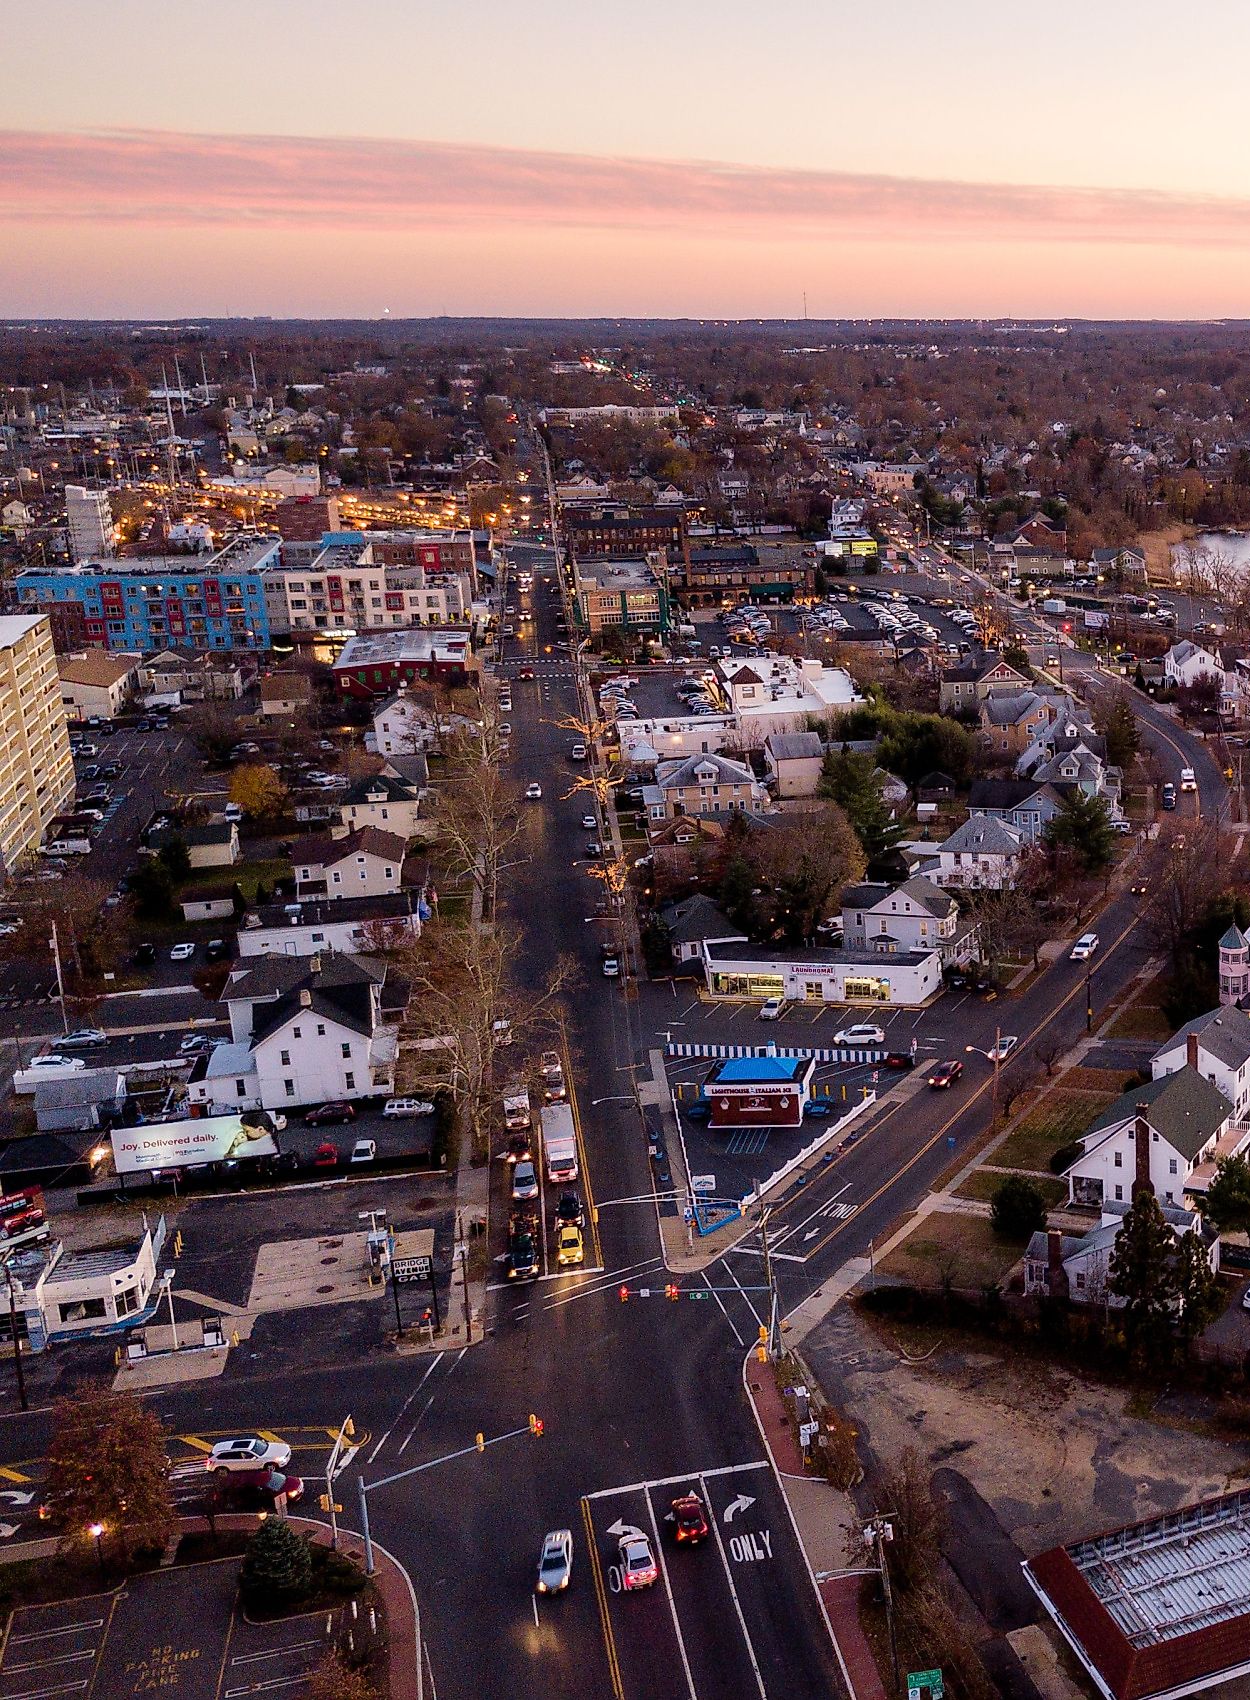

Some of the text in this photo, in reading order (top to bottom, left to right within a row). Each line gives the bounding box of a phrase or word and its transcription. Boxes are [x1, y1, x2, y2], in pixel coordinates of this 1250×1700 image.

[120, 1133, 219, 1152] Joy. Delivered daily.
[819, 1202, 859, 1218] ONLY
[394, 1259, 429, 1268] BRIDGE
[395, 1265, 430, 1274] AVENUE
[398, 1273, 428, 1282] GAS
[729, 1530, 773, 1562] ONLY
